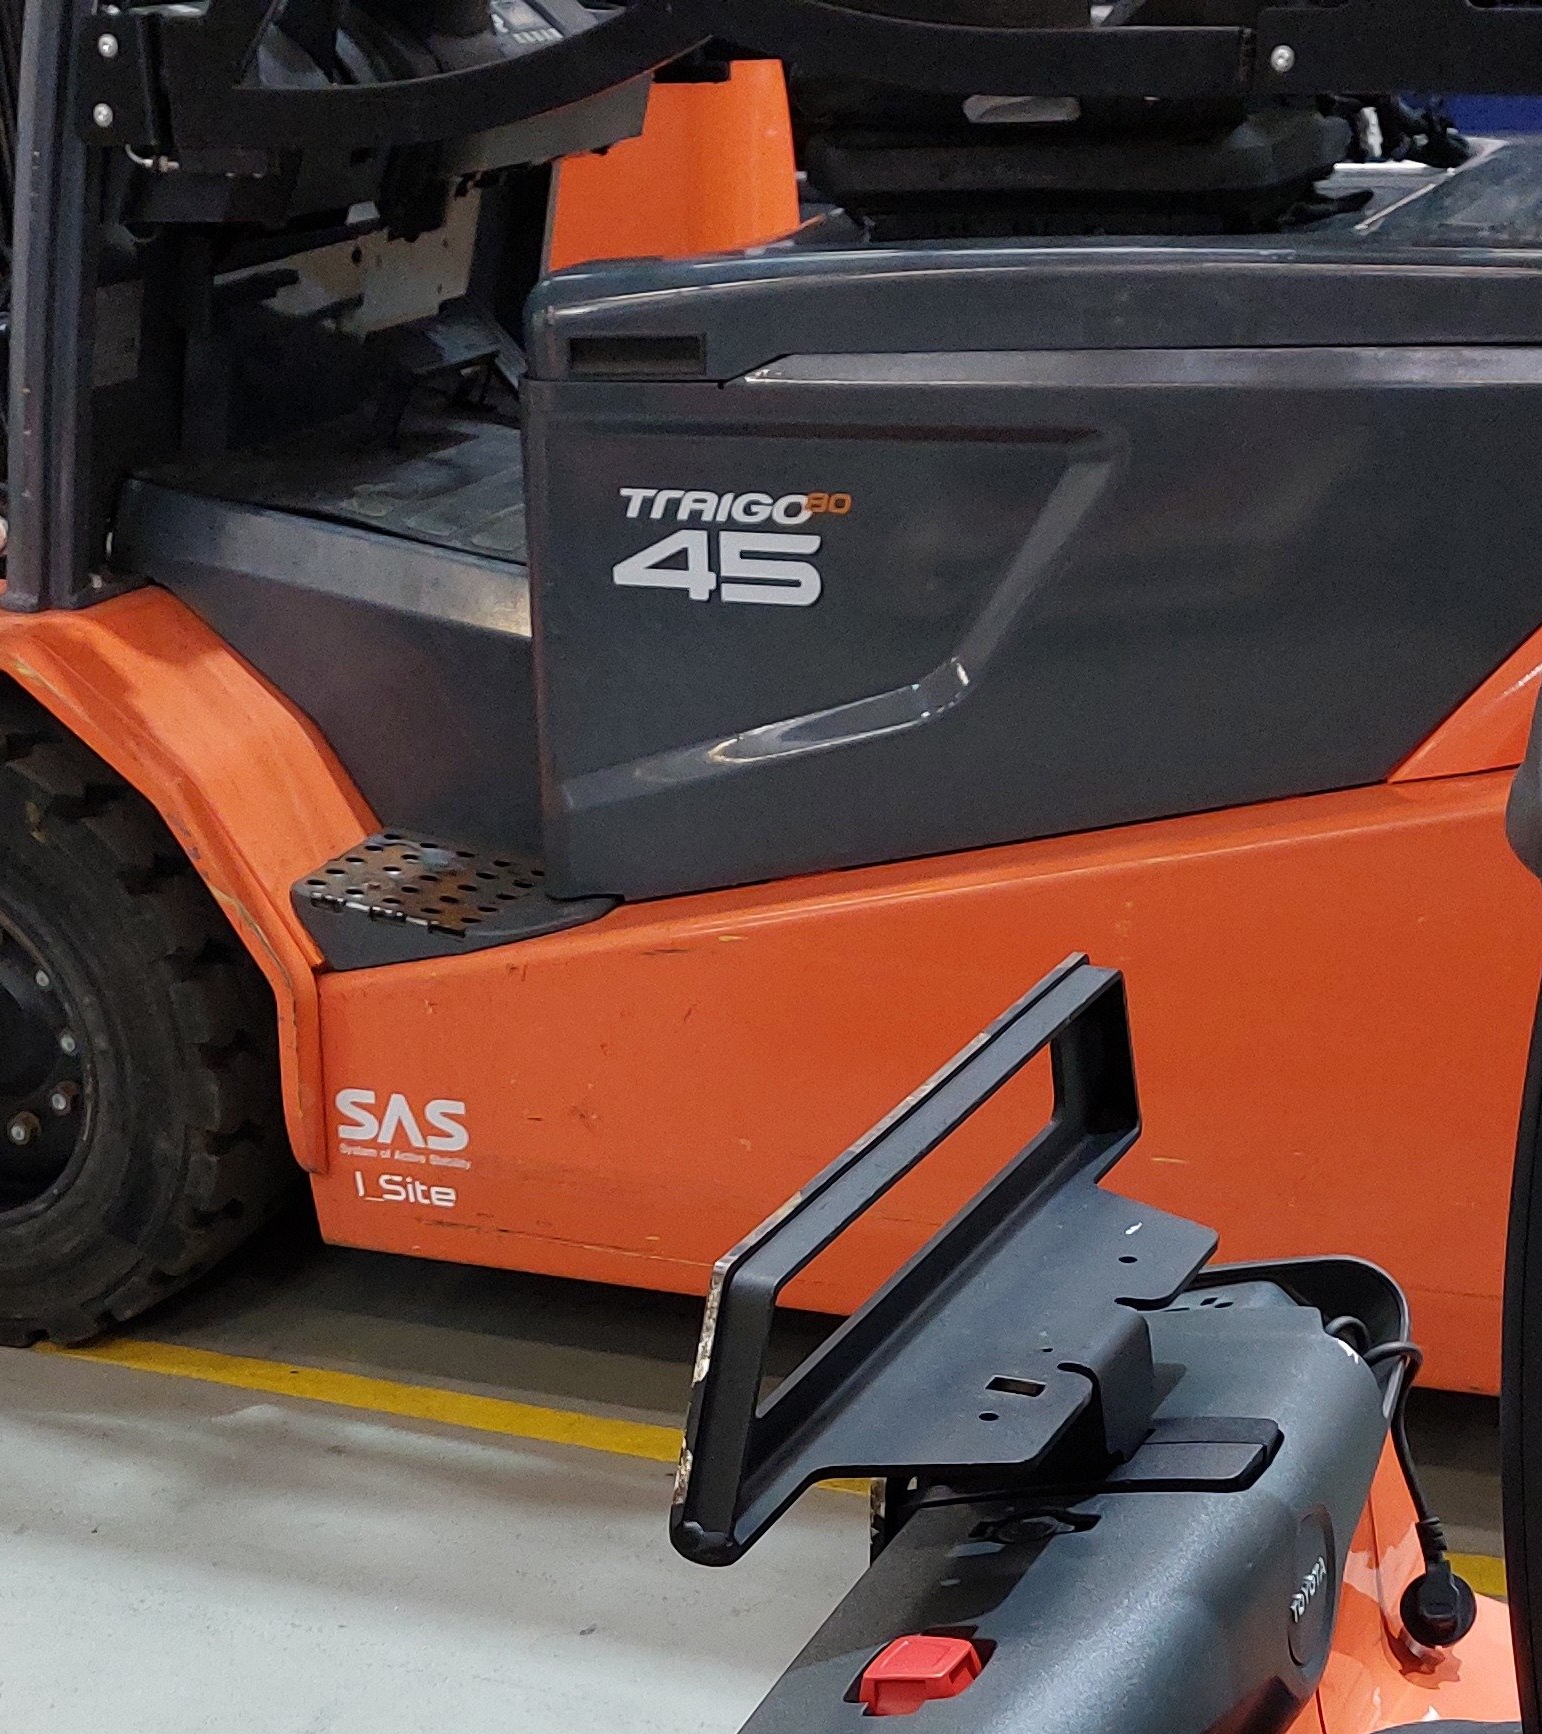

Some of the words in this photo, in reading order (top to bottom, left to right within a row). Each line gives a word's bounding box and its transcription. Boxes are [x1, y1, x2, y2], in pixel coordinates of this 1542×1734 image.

[613, 529, 822, 607] 45
[335, 1088, 469, 1151] SAS
[1290, 1556, 1327, 1624] TOYOTA
